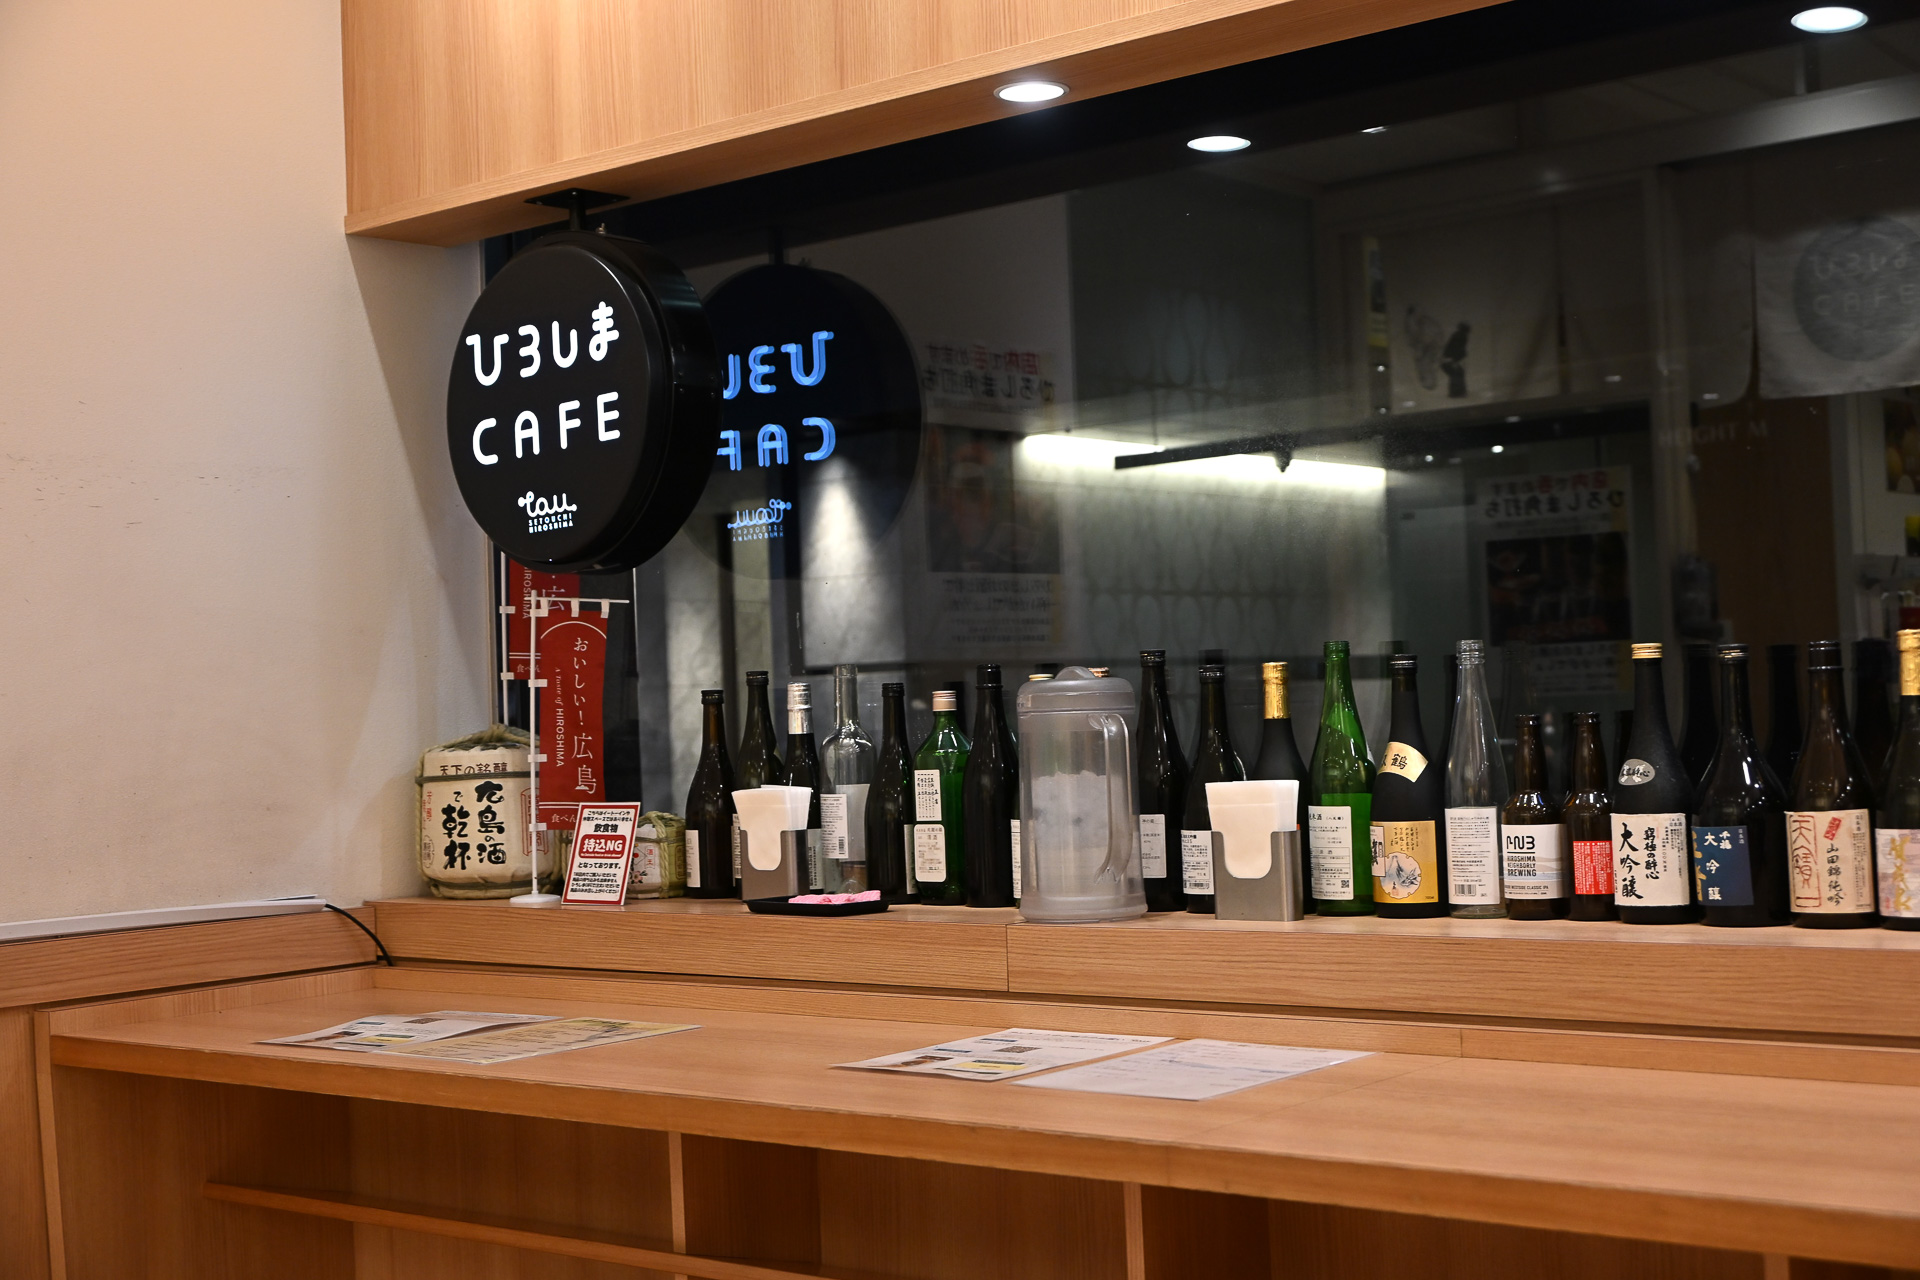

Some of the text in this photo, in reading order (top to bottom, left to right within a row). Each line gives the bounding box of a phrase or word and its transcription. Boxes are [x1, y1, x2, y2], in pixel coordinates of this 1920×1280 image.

[465, 300, 619, 386] ひろしま
[471, 391, 621, 466] CAFE
[528, 513, 572, 526] SETOUCHI
[528, 520, 573, 533] HIROSHIMA
[522, 566, 532, 619] IROSHIMA
[556, 708, 565, 767] HIROSHIMA
[441, 791, 472, 870] で乾杯
[475, 780, 507, 865] 広島の酒
[593, 823, 619, 833] 飲食物
[1719, 830, 1732, 850] 千福
[582, 838, 623, 852] 持込NG
[1507, 869, 1537, 877] BREWING
